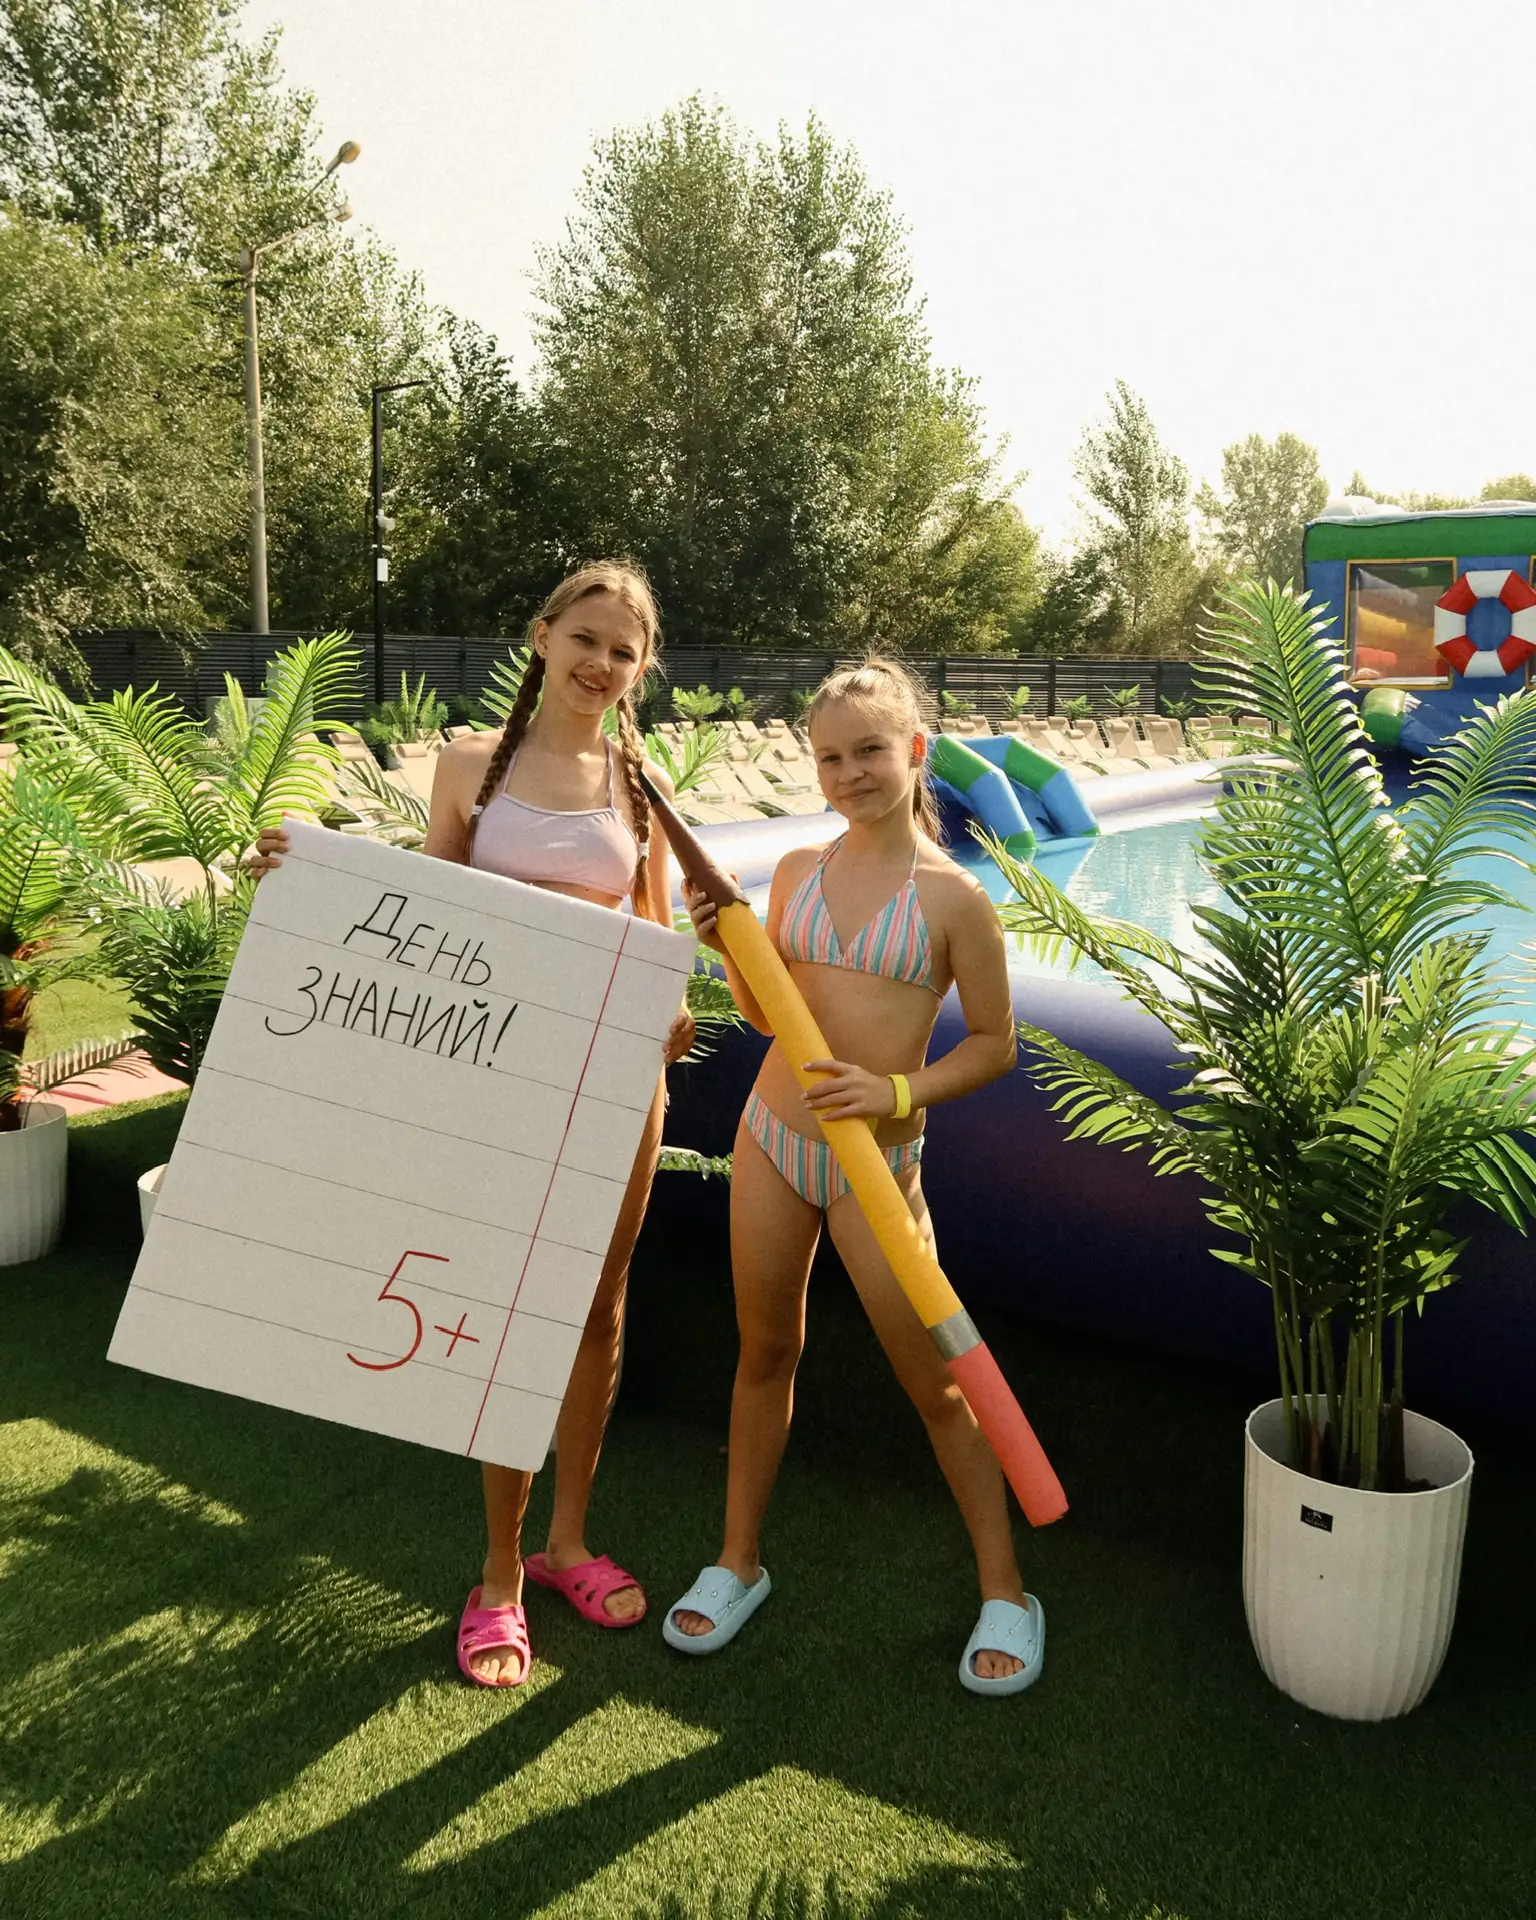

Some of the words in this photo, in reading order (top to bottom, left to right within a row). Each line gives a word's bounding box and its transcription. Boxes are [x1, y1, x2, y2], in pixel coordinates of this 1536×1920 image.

[343, 892, 492, 986] ДЕНЬ
[264, 966, 518, 1068] ЗНАНИЙ!
[346, 1250, 481, 1371] 5+
